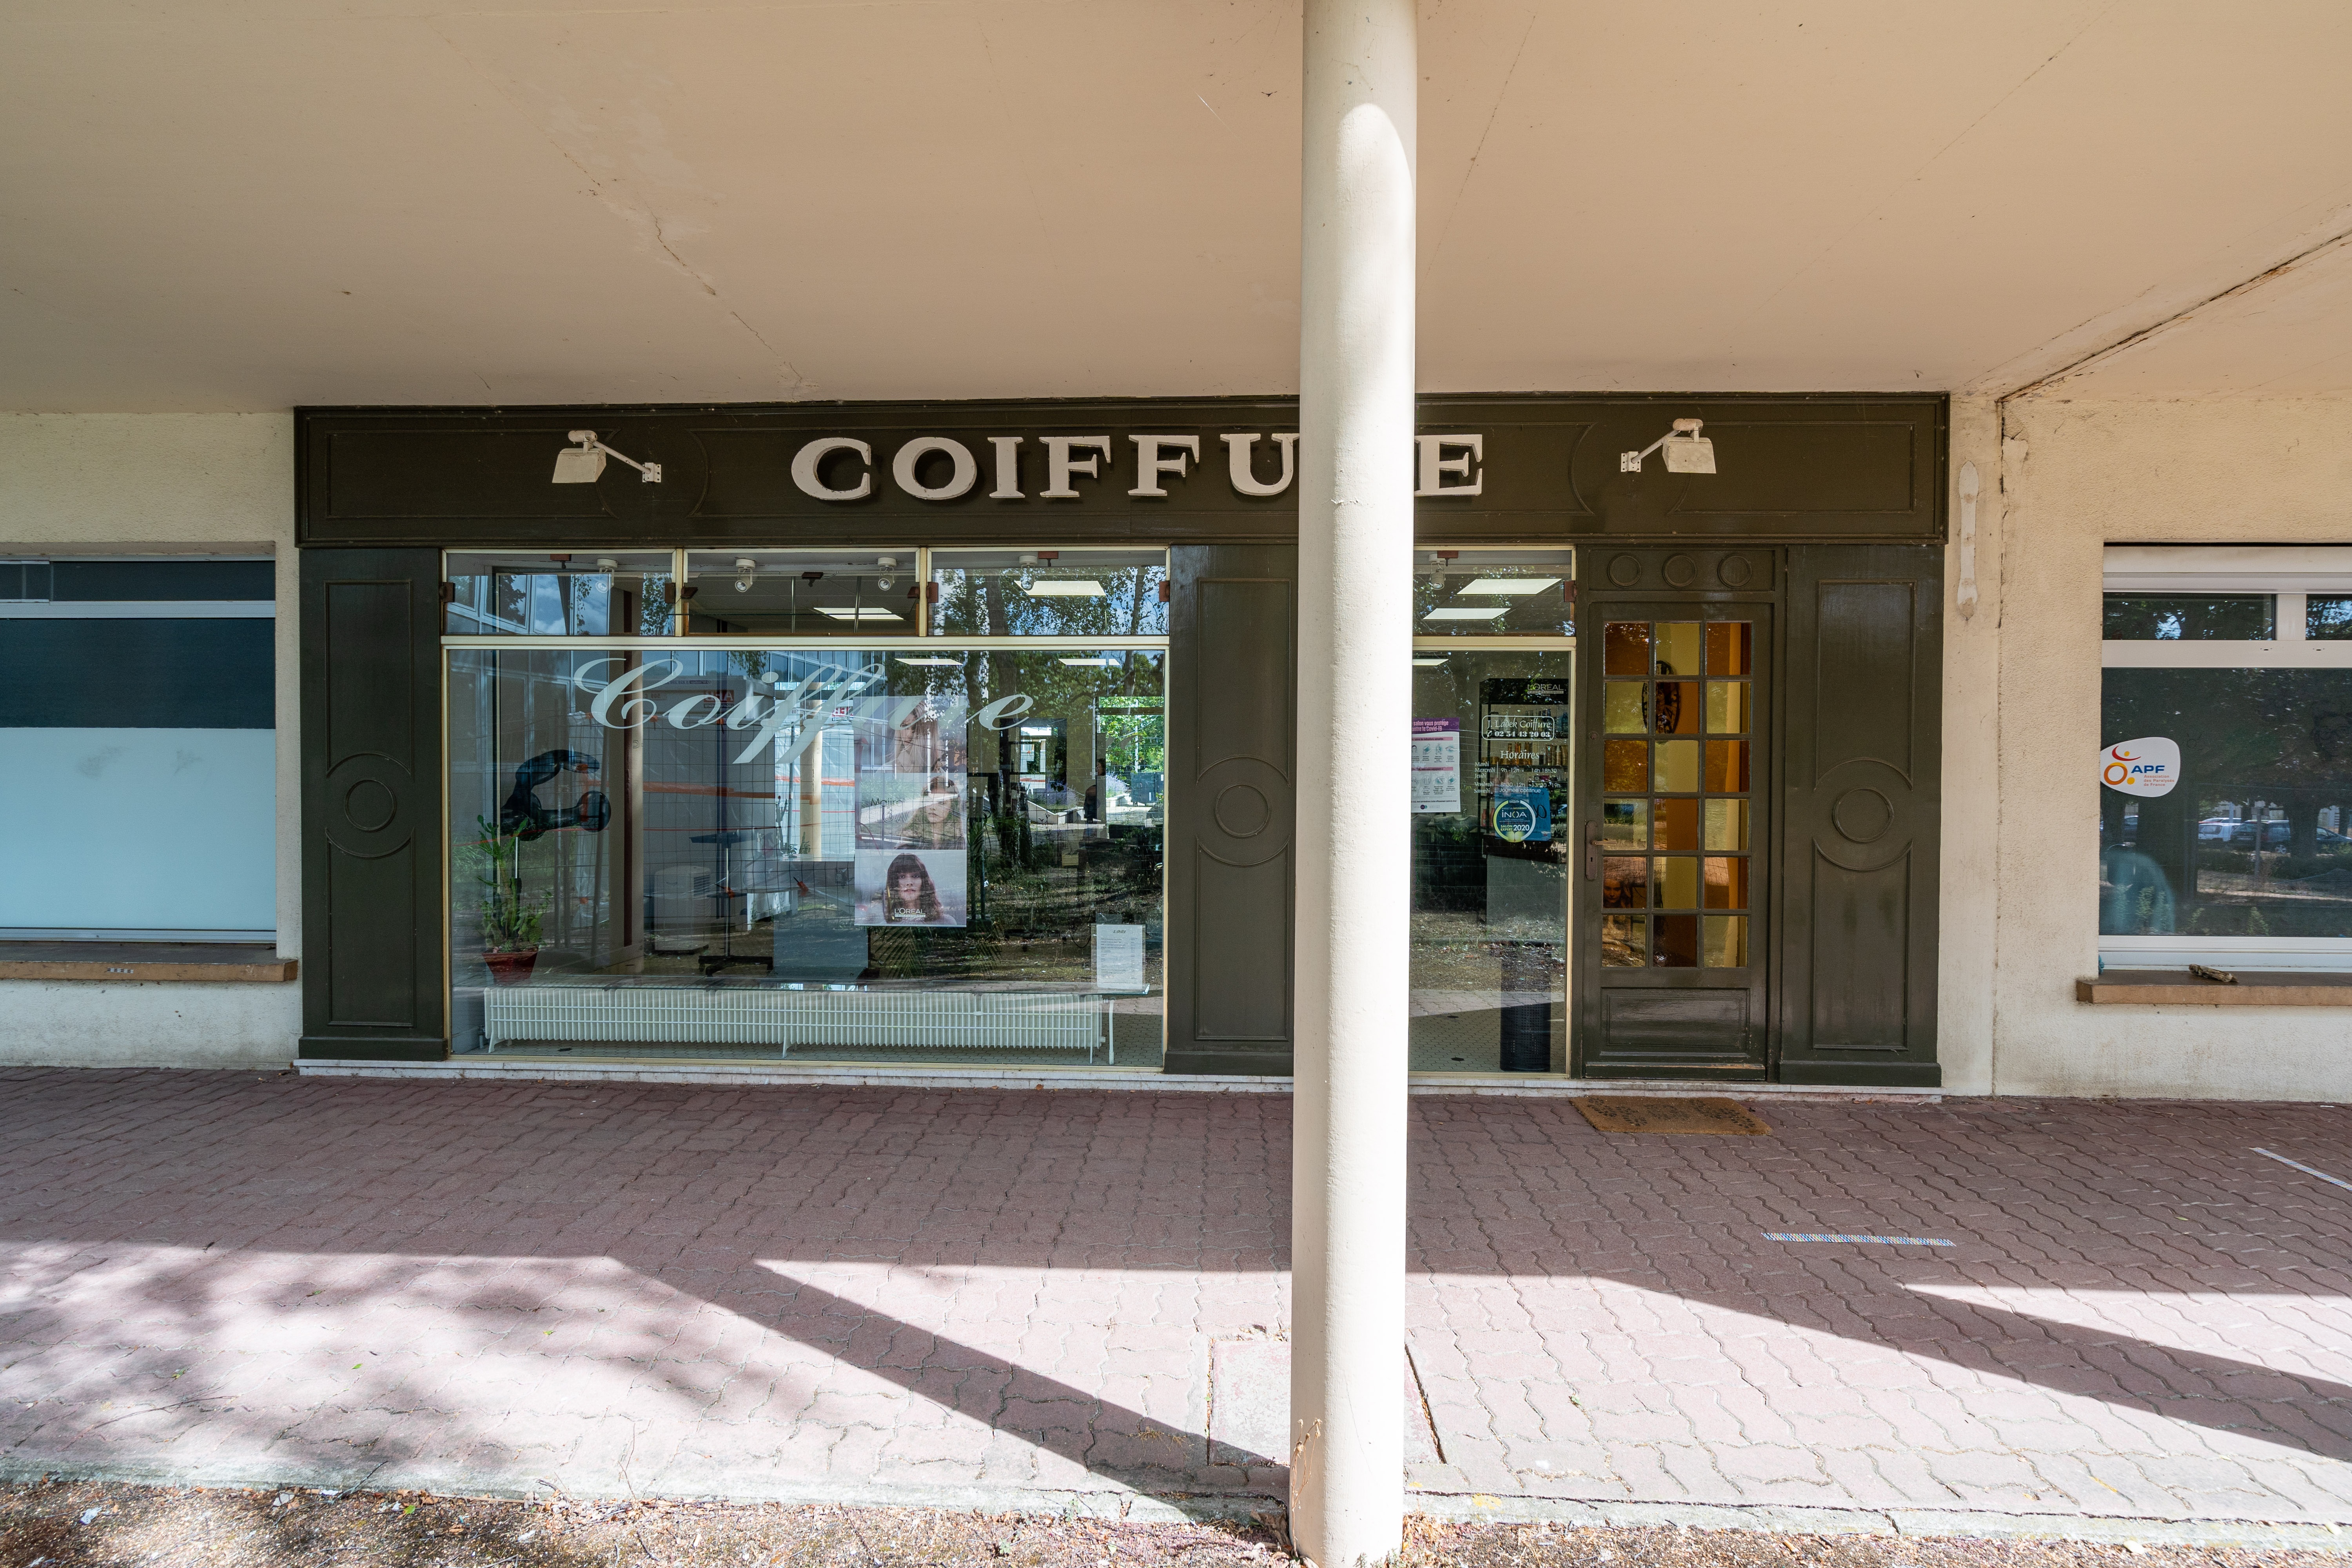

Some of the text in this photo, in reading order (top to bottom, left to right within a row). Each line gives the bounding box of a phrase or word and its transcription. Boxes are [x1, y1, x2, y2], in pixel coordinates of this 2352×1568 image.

[791, 434, 1483, 500] COIFFUE
[573, 657, 1034, 764] Coiffure
[1487, 717, 1551, 731] J. Ladek Coiffure
[1500, 750, 1540, 760] Horaires
[2131, 765, 2165, 773] APF
[871, 797, 905, 808] Majirel
[864, 810, 910, 823] GLOW
